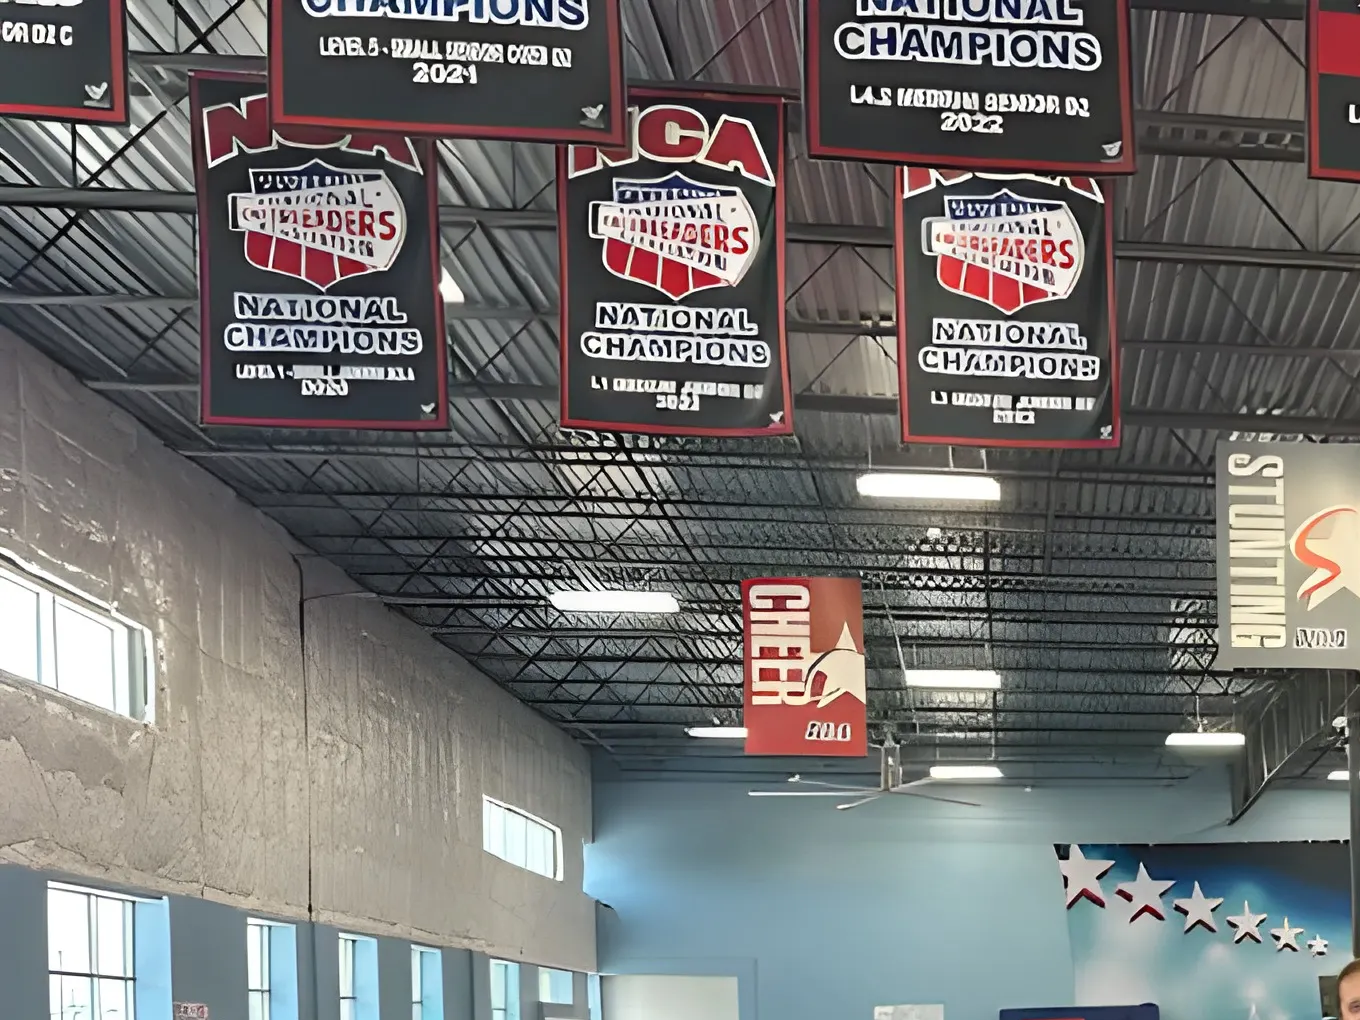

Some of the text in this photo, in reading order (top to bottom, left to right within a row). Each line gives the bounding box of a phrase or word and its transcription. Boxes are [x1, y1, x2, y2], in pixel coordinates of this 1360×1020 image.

[838, 26, 1098, 68] CHAMPIONS
[568, 105, 776, 187] NCA
[237, 294, 406, 322] NATIONAL
[598, 305, 757, 333] NATIONAL
[226, 325, 420, 352] CHAMPIONS
[934, 321, 1085, 348] NATIONAL
[582, 335, 769, 364] CHAMPIONS
[921, 349, 1098, 379] CHAMPIONS
[1228, 453, 1287, 649] STUNTING
[749, 584, 811, 706] CHEER
